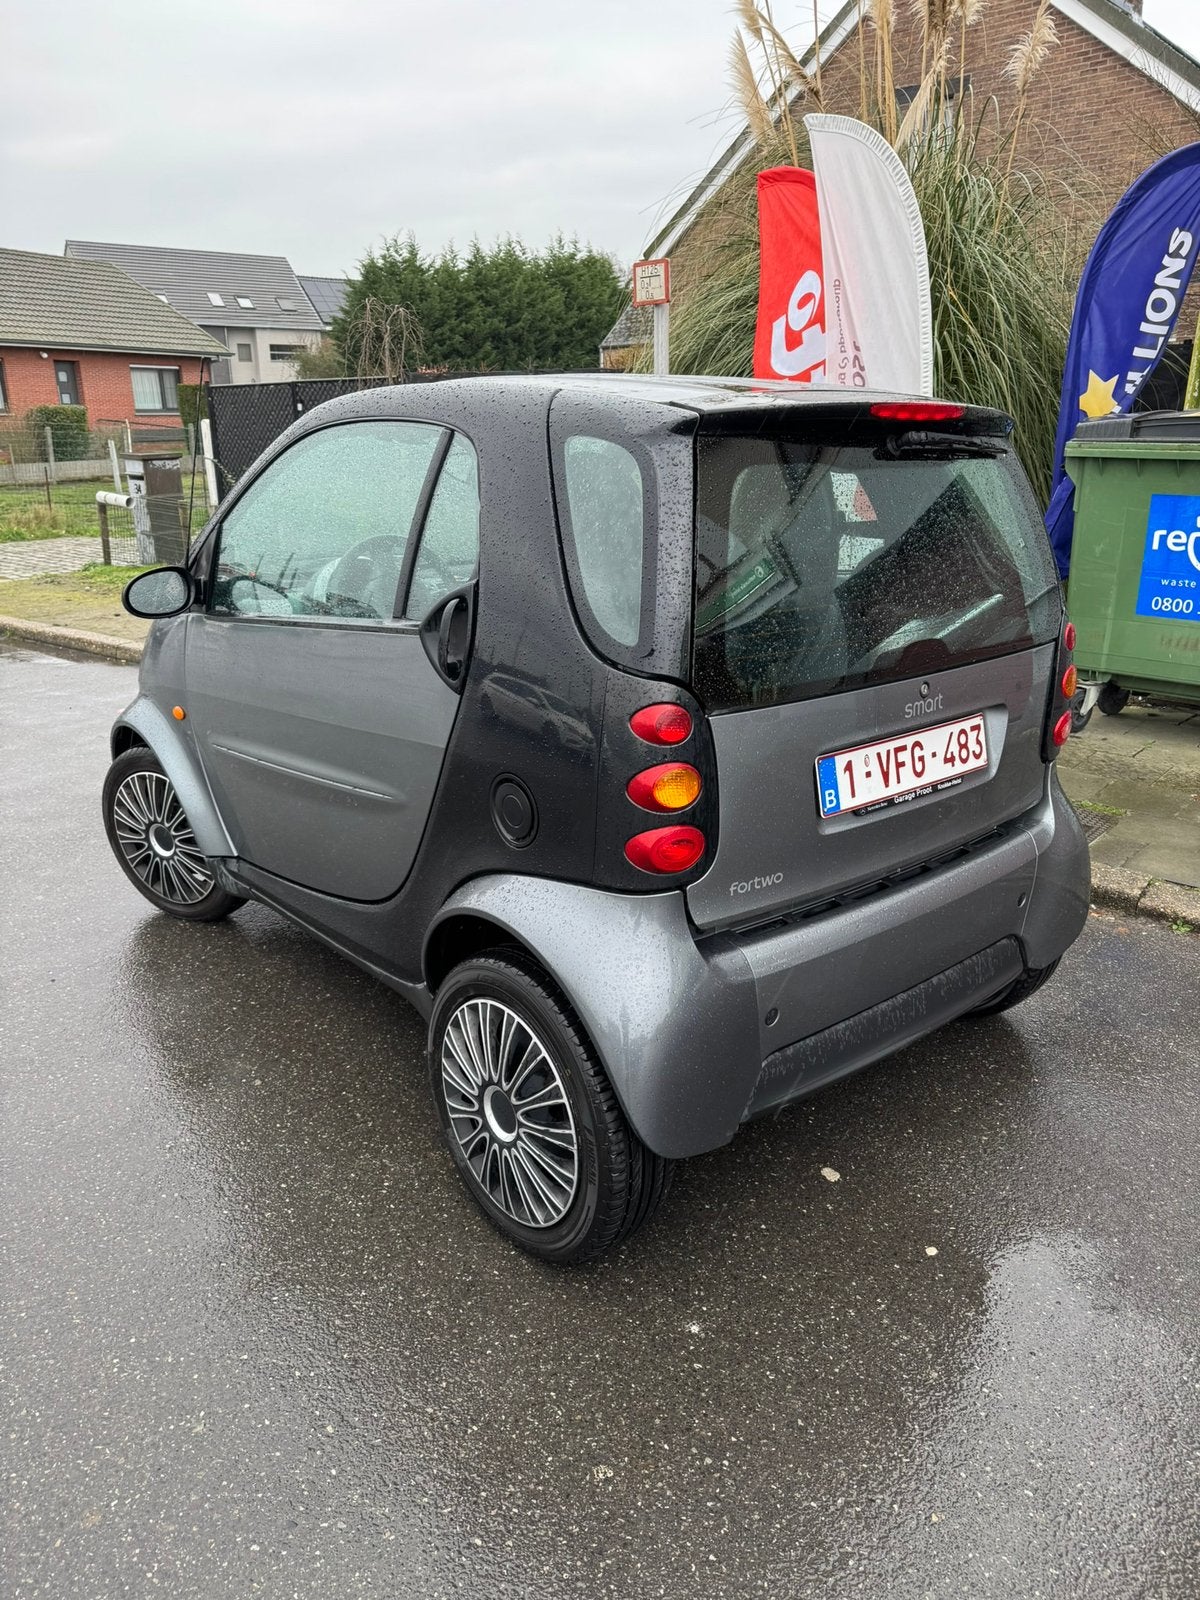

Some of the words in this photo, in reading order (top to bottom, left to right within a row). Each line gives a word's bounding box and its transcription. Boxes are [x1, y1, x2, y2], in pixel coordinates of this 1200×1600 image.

[1161, 578, 1197, 589] waste
[1151, 596, 1194, 614] 0800
[905, 692, 943, 718] smart
[843, 723, 984, 800] 1-VFG-483
[825, 789, 837, 809] B
[893, 791, 915, 804] Garage
[916, 786, 933, 797] Proot
[729, 872, 784, 897] fortwo
